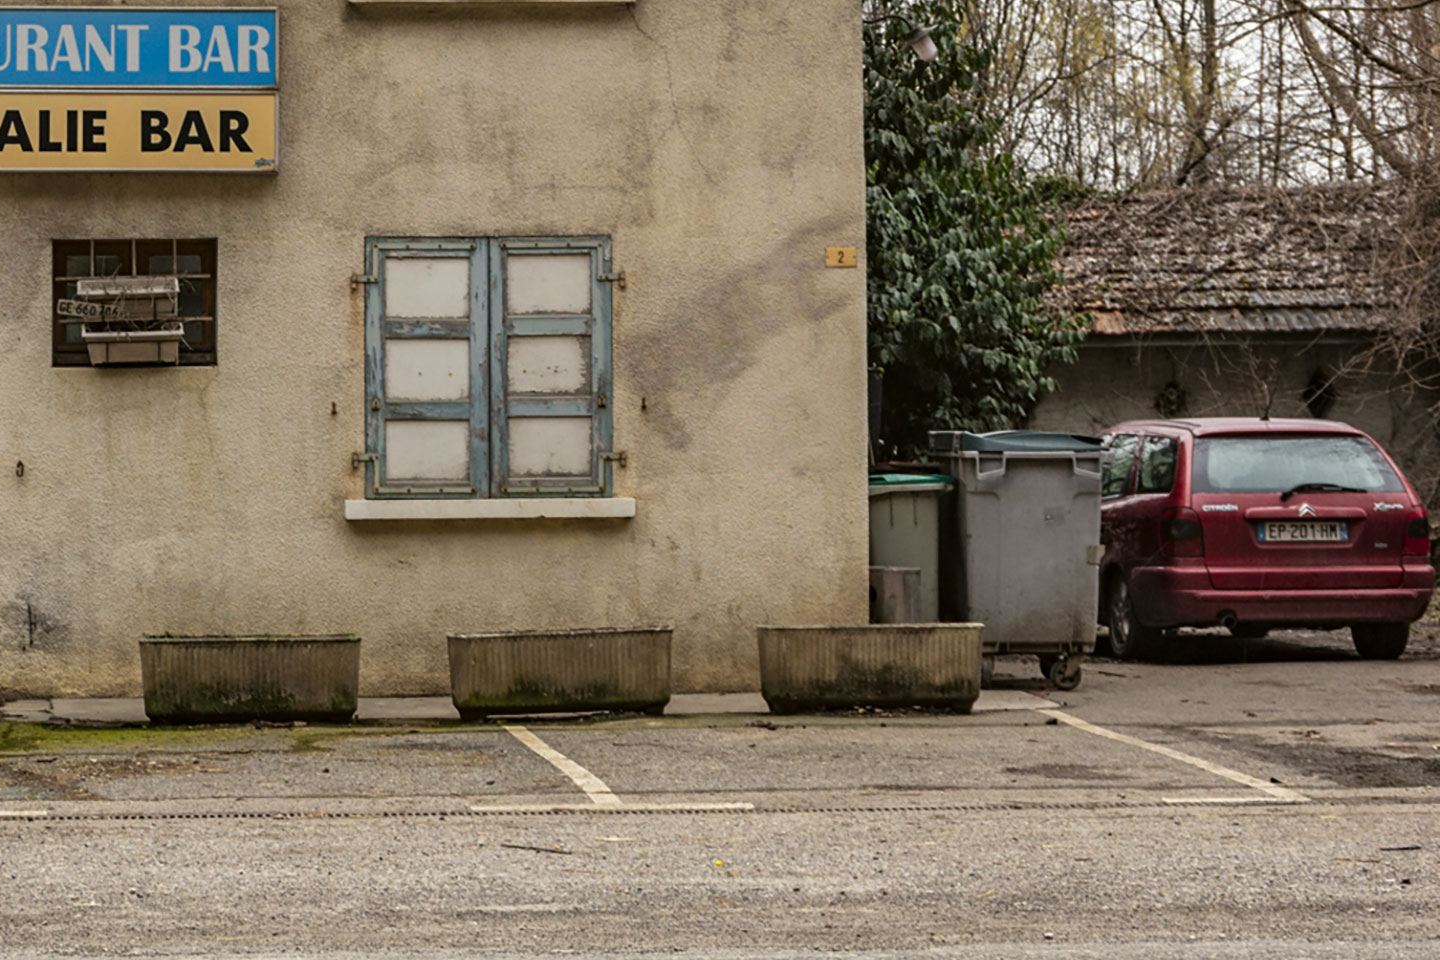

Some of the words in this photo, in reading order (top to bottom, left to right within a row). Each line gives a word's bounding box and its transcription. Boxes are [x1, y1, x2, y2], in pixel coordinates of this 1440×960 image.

[168, 24, 271, 73] BAR
[140, 110, 254, 153] BAR
[837, 250, 845, 264] 2
